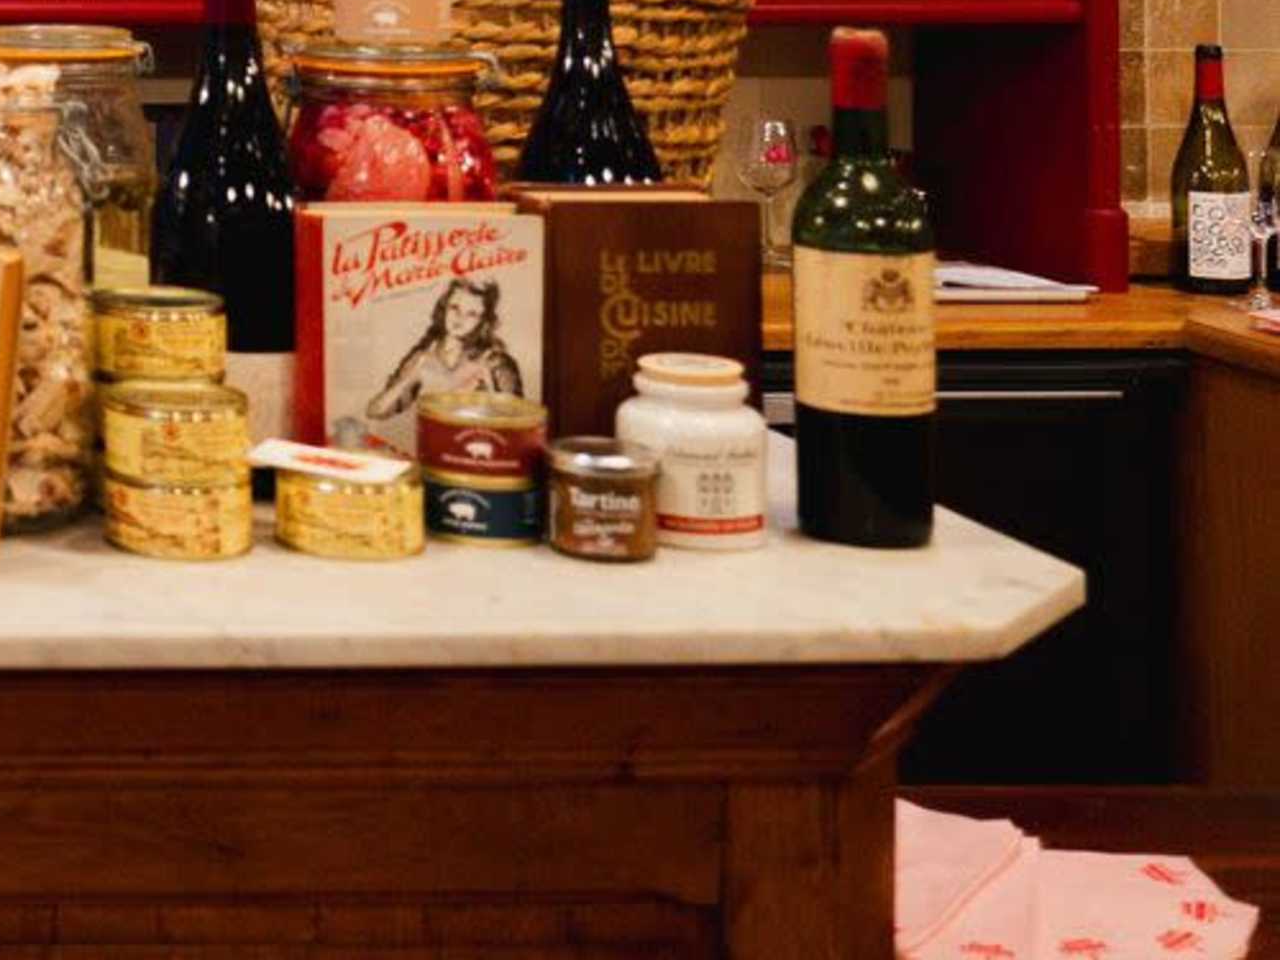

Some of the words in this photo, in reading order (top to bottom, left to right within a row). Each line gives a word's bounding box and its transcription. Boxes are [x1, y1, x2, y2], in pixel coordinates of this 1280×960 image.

[332, 243, 361, 276] la
[637, 249, 717, 273] LIVRE
[568, 486, 640, 514] Tartine
